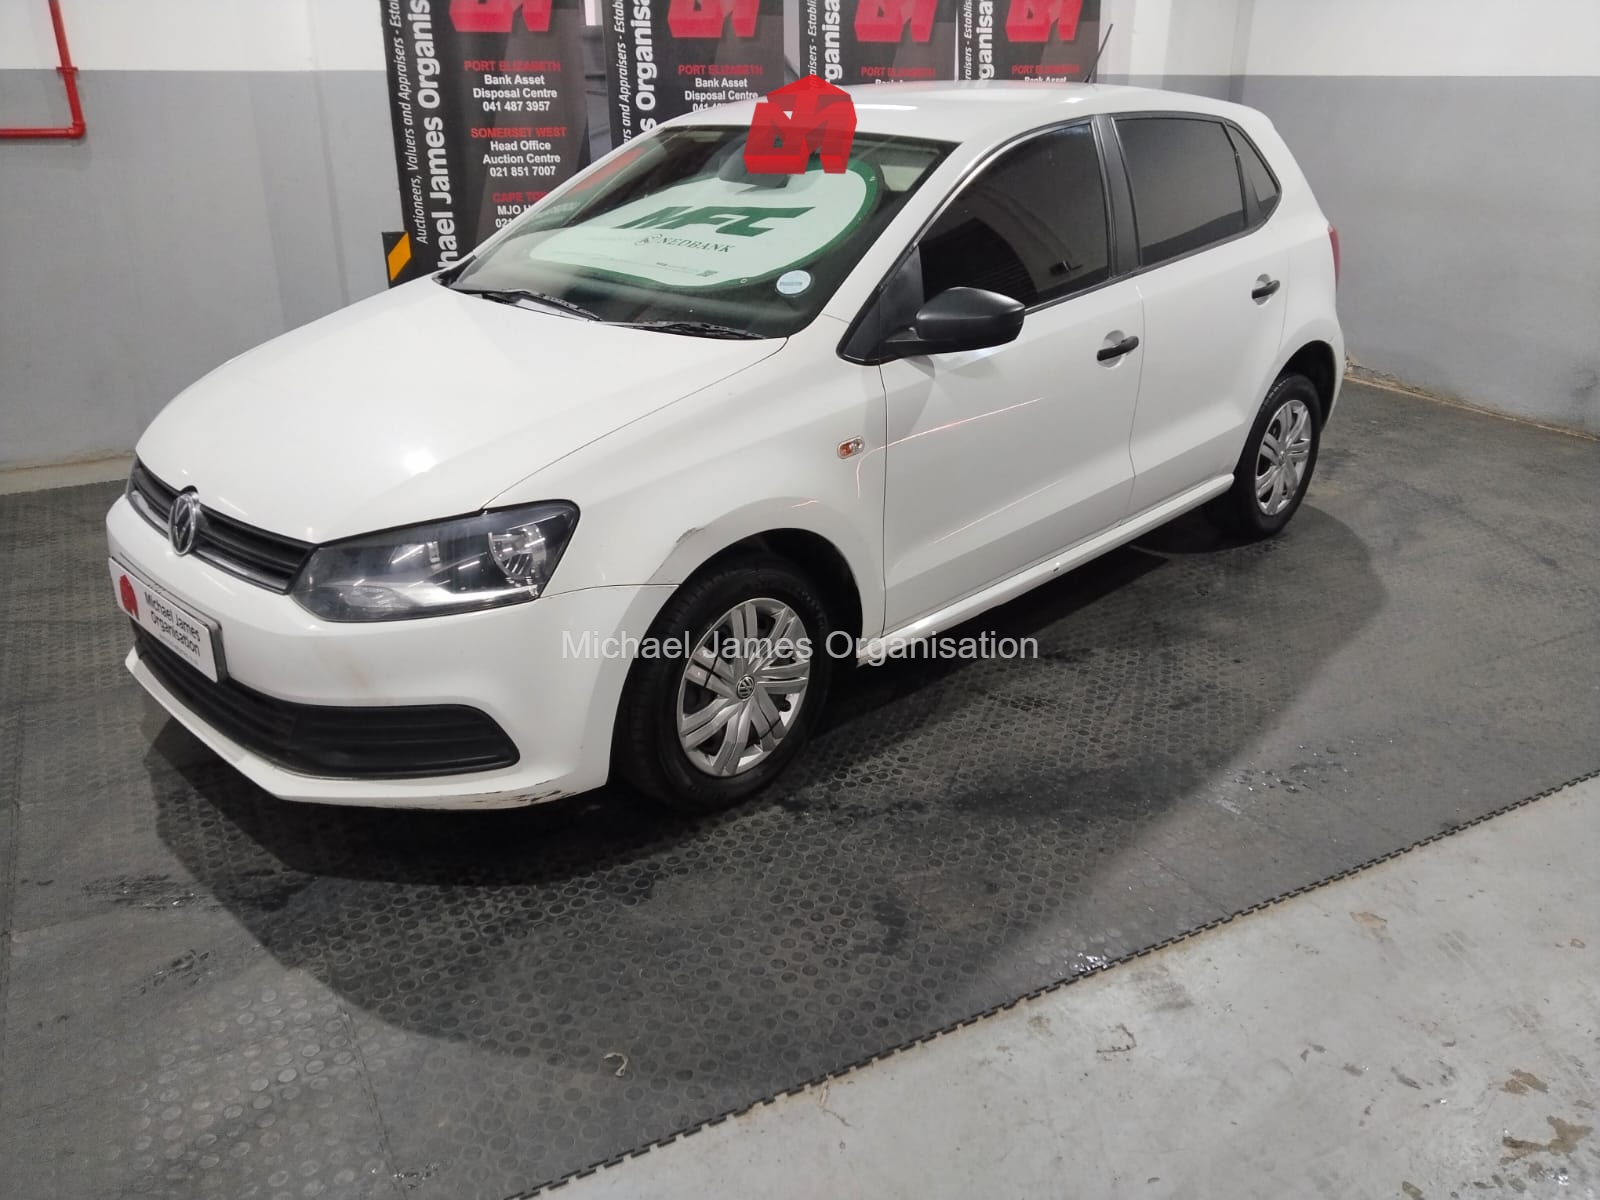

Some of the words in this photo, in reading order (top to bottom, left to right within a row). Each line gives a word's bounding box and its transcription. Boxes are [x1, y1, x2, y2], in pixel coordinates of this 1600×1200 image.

[393, 37, 411, 101] Appraisers
[463, 60, 497, 72] PORT
[677, 64, 706, 75] PORT
[616, 42, 631, 103] Appraisers
[483, 74, 512, 85] Bank
[514, 74, 545, 85] Asset
[694, 77, 720, 88] Bank
[720, 77, 748, 88] Asset
[472, 87, 520, 100] Disposal
[522, 88, 558, 98] Centre
[684, 90, 726, 102] Disposal
[727, 90, 759, 100] Centre
[482, 101, 501, 112] 041
[504, 101, 523, 111] 487
[526, 101, 551, 111] 3957
[398, 101, 413, 126] and
[619, 103, 631, 127] and
[470, 127, 532, 138] SOMERSET
[535, 126, 568, 137] WEST
[404, 129, 418, 171] Valuers
[489, 140, 518, 152] Head
[519, 139, 552, 151] Office
[423, 116, 452, 205] James
[482, 153, 524, 165] Auction
[526, 153, 561, 163] Centre
[489, 166, 508, 177] 021
[510, 166, 529, 176] 851
[532, 165, 556, 176] 7007
[492, 191, 523, 203] CAPE
[409, 175, 428, 244] Auctioneers,
[496, 204, 521, 216] MJO
[144, 591, 174, 623] Michael
[175, 613, 201, 642] James
